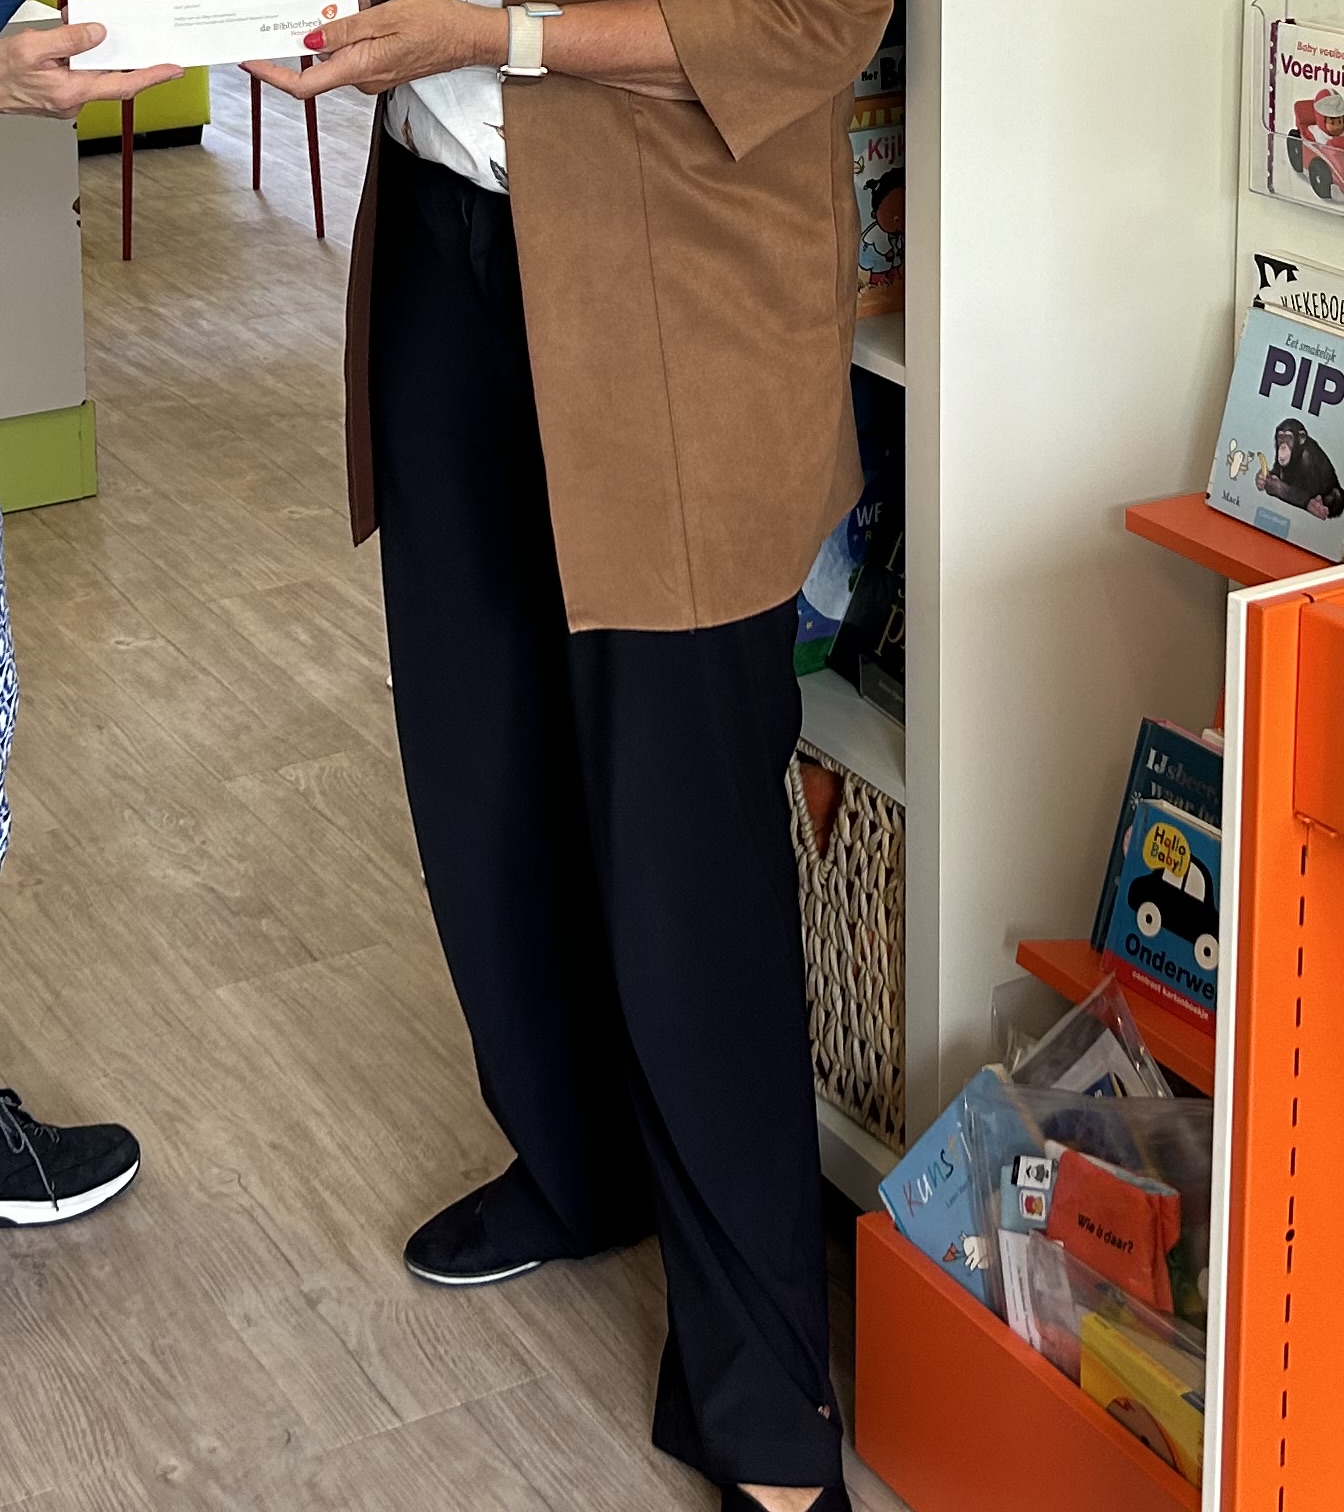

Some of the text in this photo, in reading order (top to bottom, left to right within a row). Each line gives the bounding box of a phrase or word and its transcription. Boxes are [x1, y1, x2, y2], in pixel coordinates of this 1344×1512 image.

[260, 22, 272, 33] de
[1296, 41, 1318, 56] Baby
[861, 70, 878, 81] Het
[1285, 332, 1337, 364] Eet smakelijk
[1150, 841, 1185, 873] Baby!
[1153, 825, 1187, 857] Hallo
[1077, 1212, 1096, 1236] Wie
[1103, 1229, 1135, 1255] daar?
